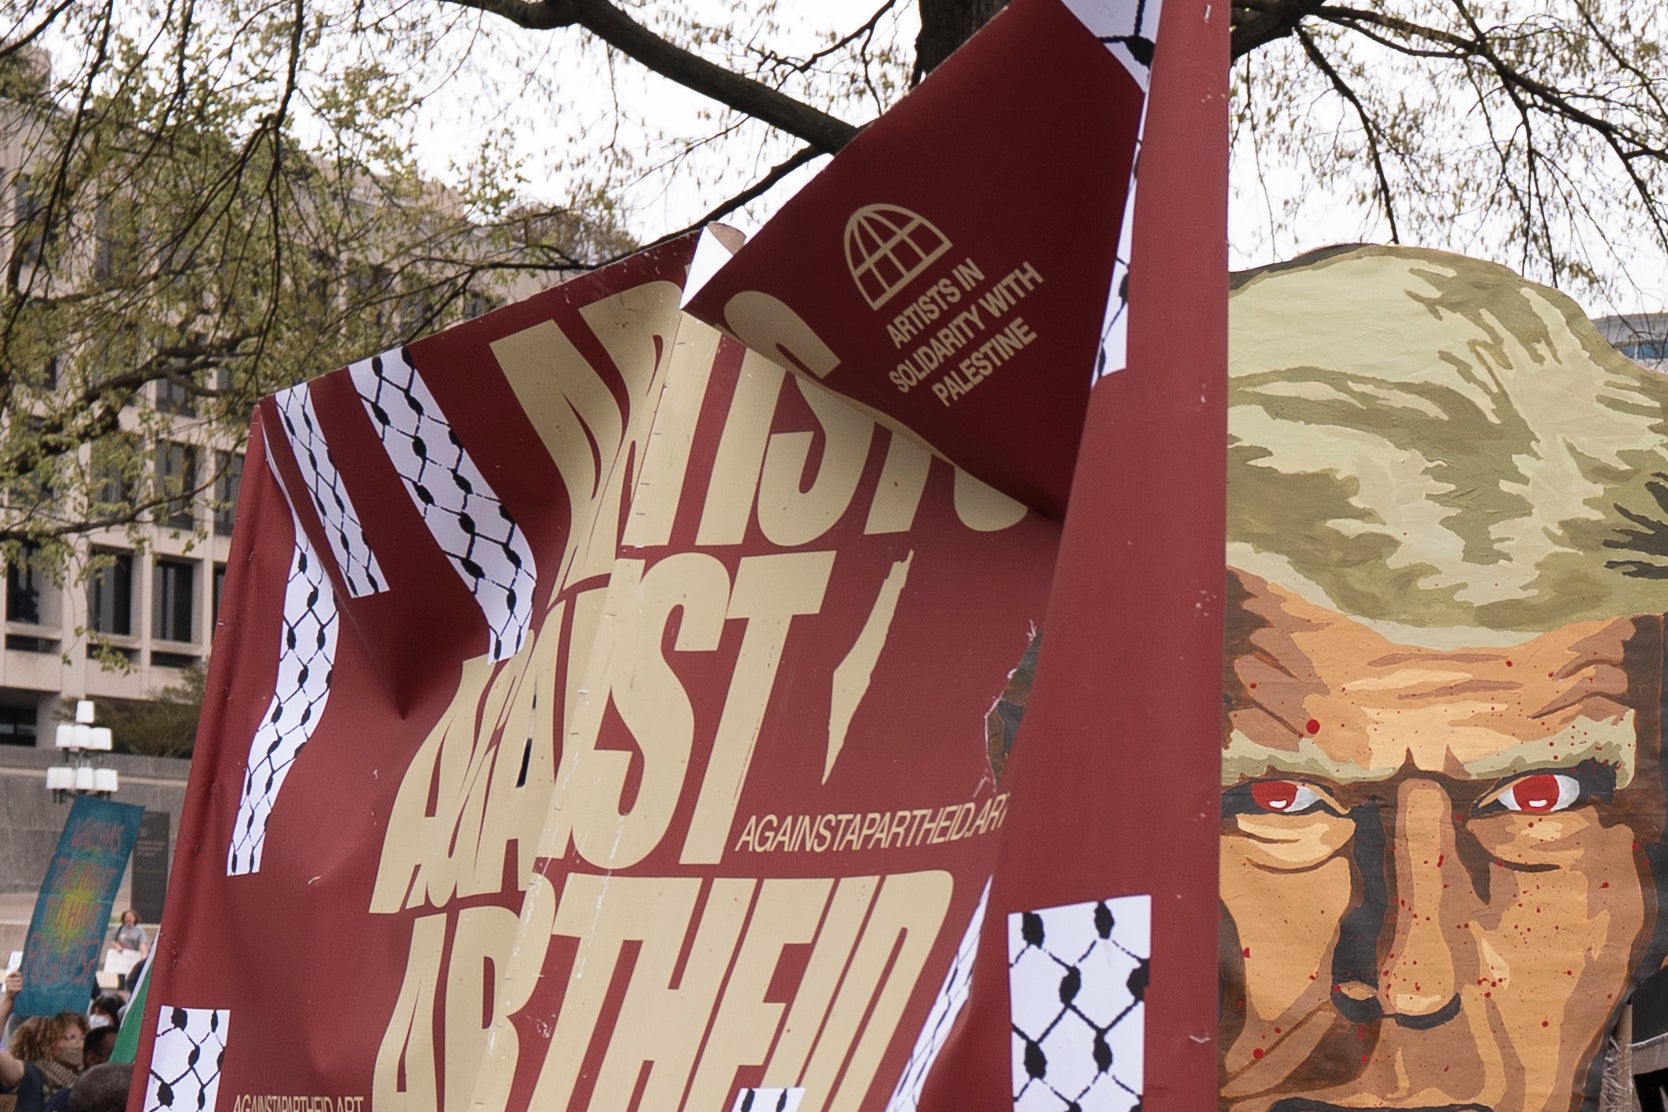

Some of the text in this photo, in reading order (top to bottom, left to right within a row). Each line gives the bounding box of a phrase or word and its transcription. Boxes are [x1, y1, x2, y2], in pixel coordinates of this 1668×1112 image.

[886, 258, 985, 349] ARTISTS IN
[889, 261, 1044, 393] SOLIDARITY WITH
[932, 317, 1037, 407] PALESTINE
